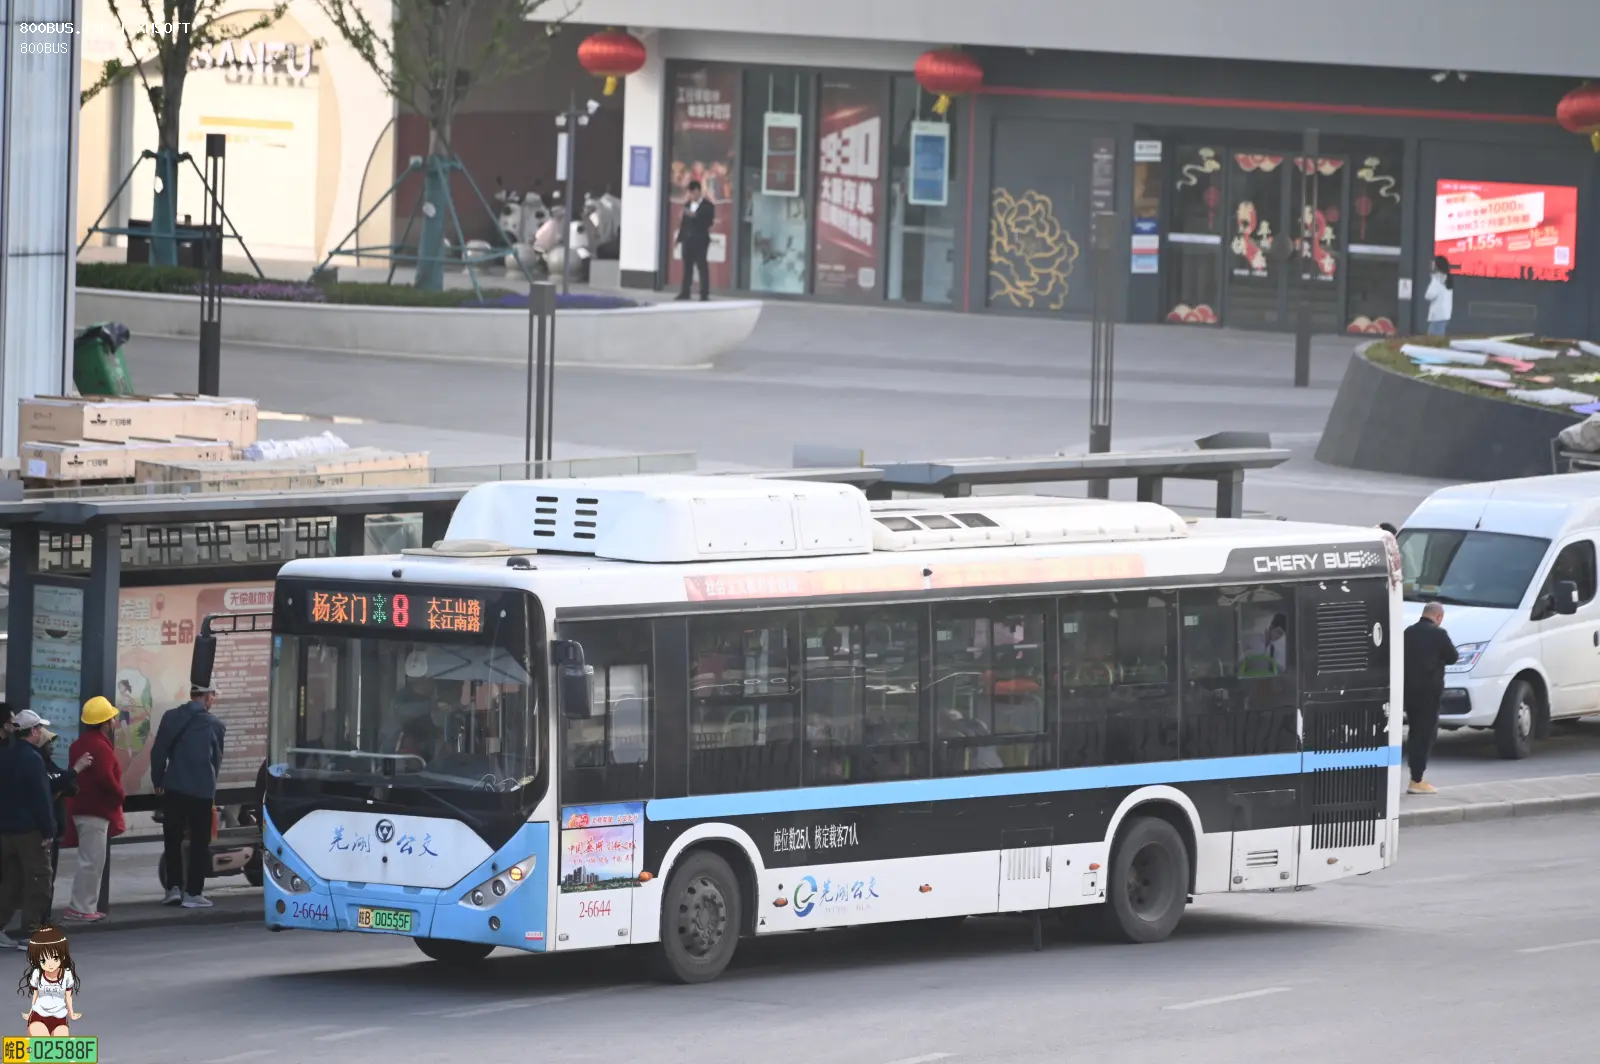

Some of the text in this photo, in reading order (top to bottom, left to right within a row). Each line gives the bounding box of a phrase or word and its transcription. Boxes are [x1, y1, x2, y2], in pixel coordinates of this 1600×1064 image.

[1253, 552, 1361, 573] CHERY BUS
[312, 592, 409, 627] 杨家门 8
[427, 597, 481, 616] 大工山路
[161, 619, 195, 646] 生命
[428, 614, 481, 632] 长江南路
[396, 833, 438, 857] 公交
[773, 822, 858, 852] 座位数25人 核定载客71人
[819, 876, 880, 905] 芜湖公交
[292, 902, 329, 920] 2-6644
[579, 900, 612, 918] 2-6644
